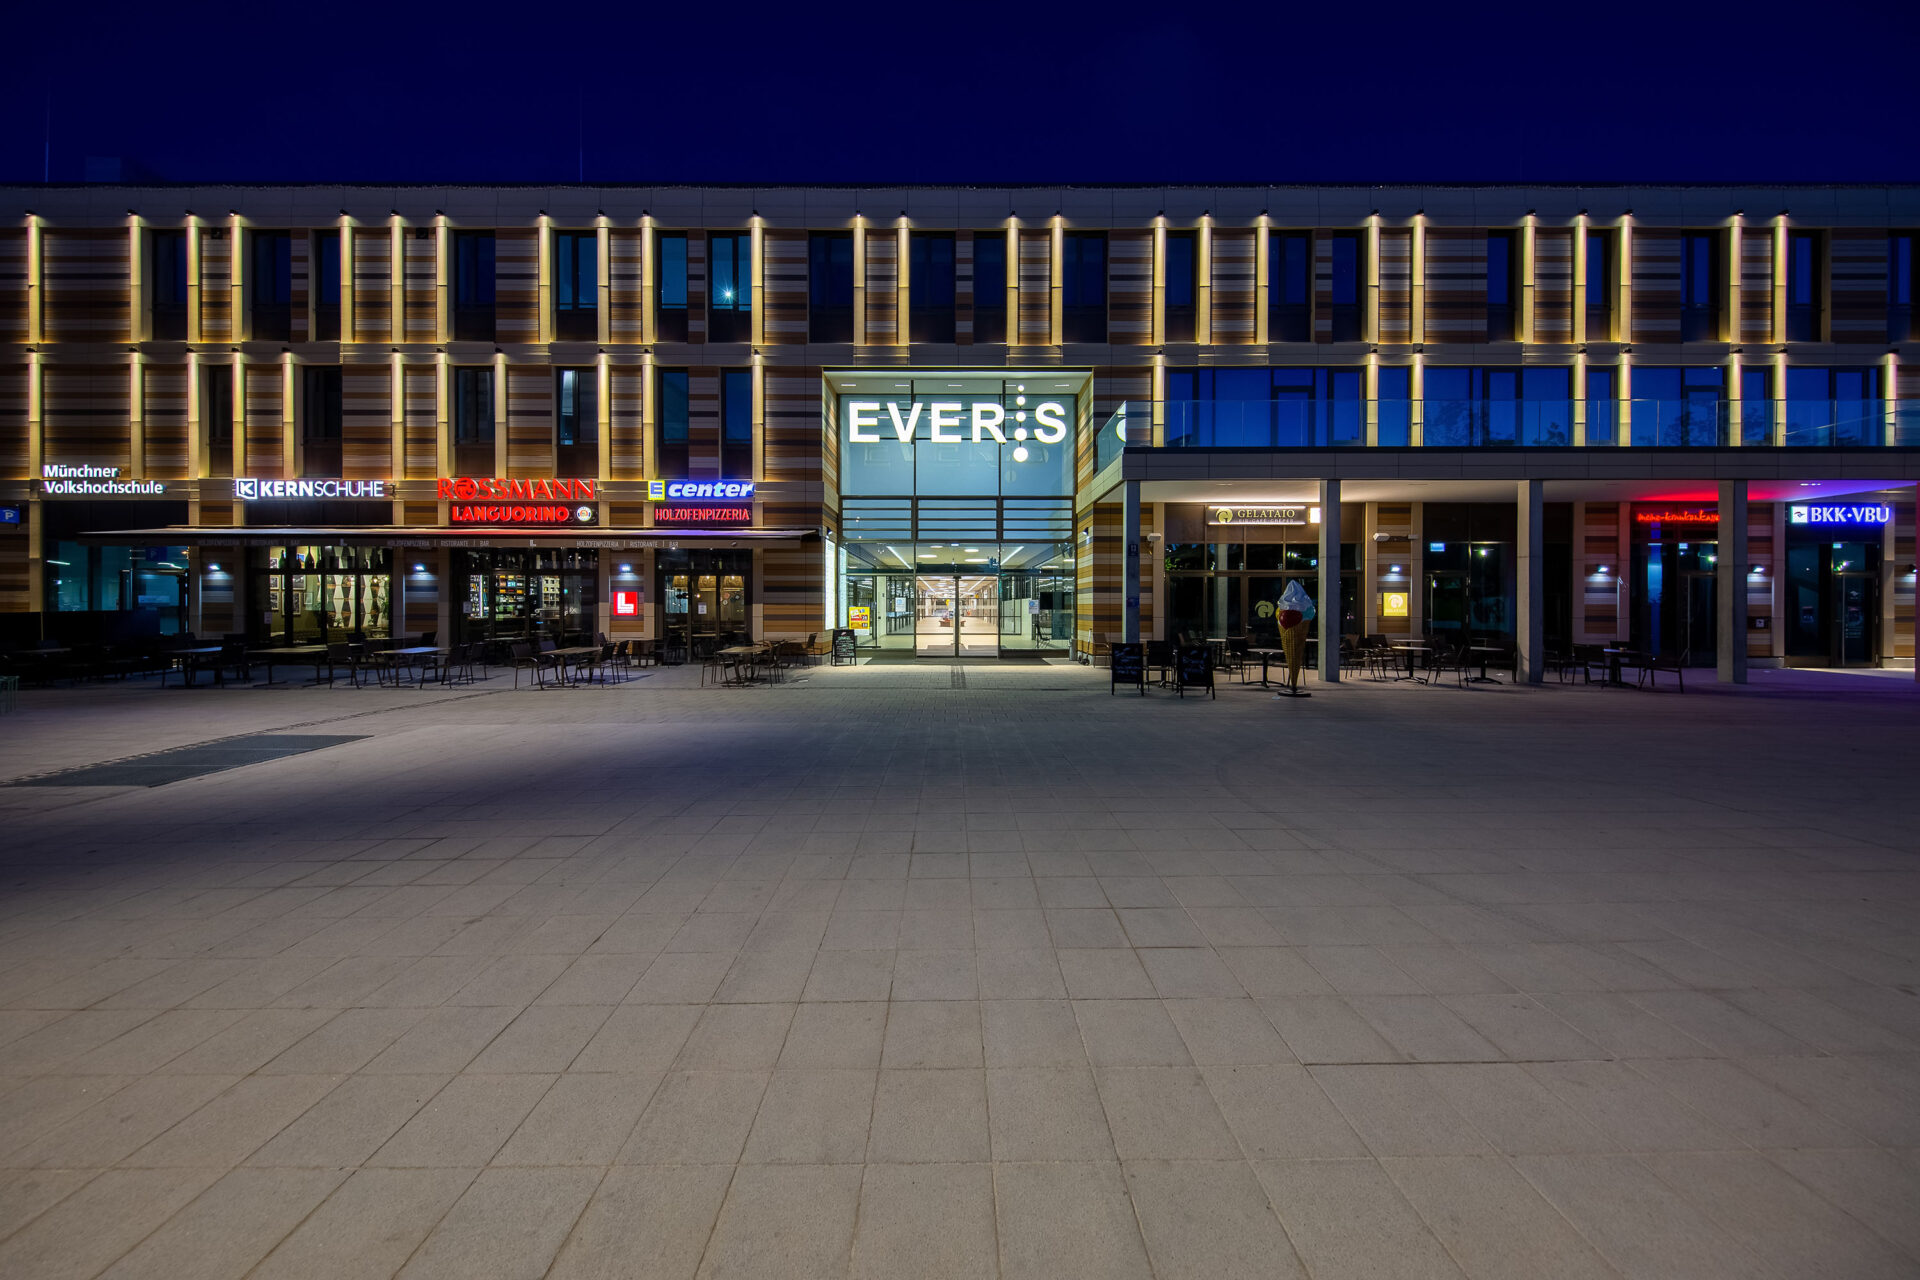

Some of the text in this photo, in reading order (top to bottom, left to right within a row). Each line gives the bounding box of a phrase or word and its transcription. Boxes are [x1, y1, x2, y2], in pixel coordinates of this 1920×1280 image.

[43, 464, 117, 478] Münchner
[44, 480, 164, 494] Volkshochschule
[260, 481, 385, 497] KERNSCHUHE
[437, 477, 594, 500] ROSSMANN
[668, 482, 754, 497] center
[452, 506, 569, 521] LANGUORINO
[655, 508, 750, 521] HOLZOFENPIZZERIA
[1237, 509, 1295, 518] GELATAIO
[617, 592, 634, 614] L
